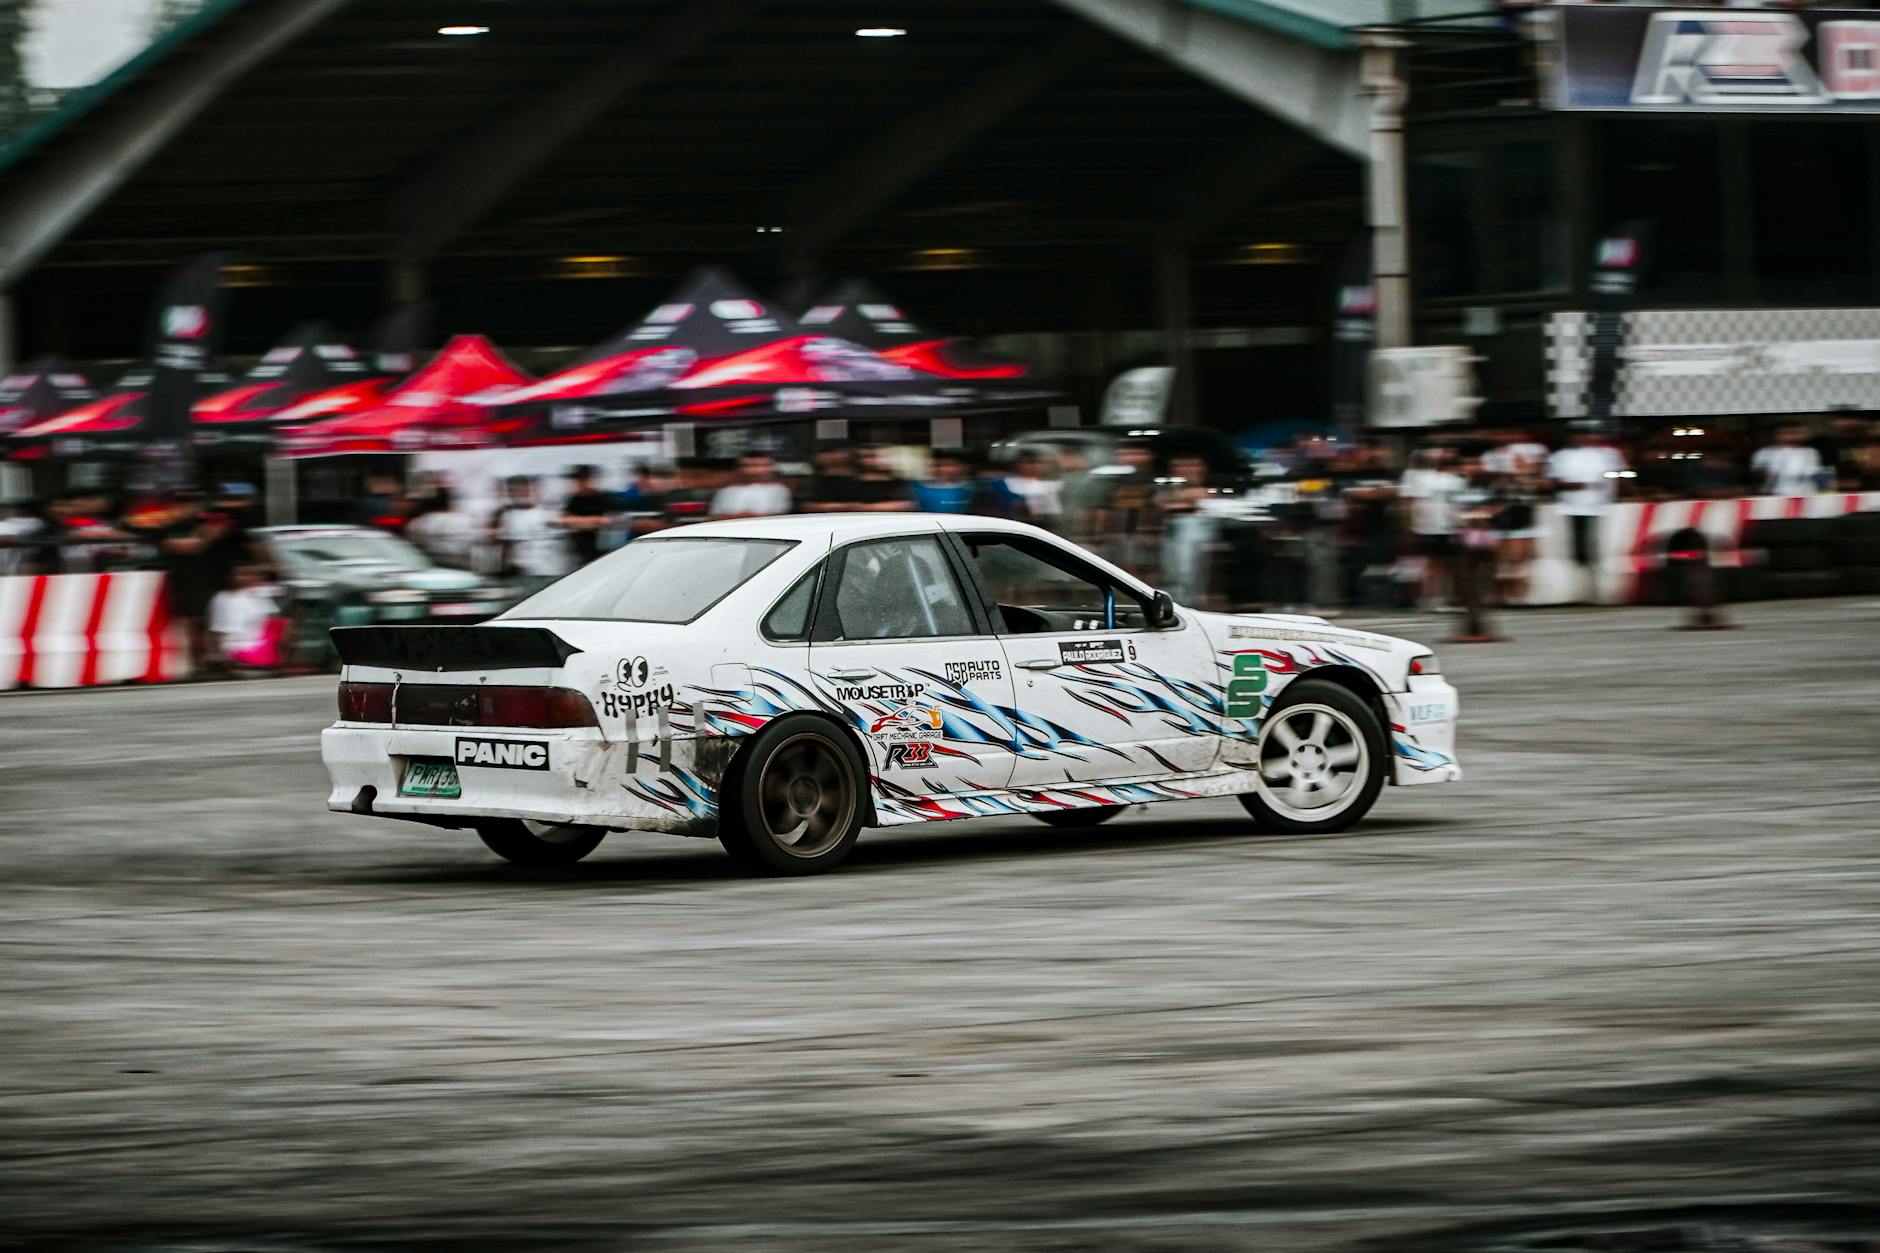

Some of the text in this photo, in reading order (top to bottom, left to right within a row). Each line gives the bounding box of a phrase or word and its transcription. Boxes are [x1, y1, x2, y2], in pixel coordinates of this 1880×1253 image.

[1128, 645, 1137, 661] 9
[968, 660, 1000, 671] AUTO
[969, 671, 1002, 681] PARTS
[919, 731, 943, 739] GARAGE
[458, 740, 547, 767] PANIC
